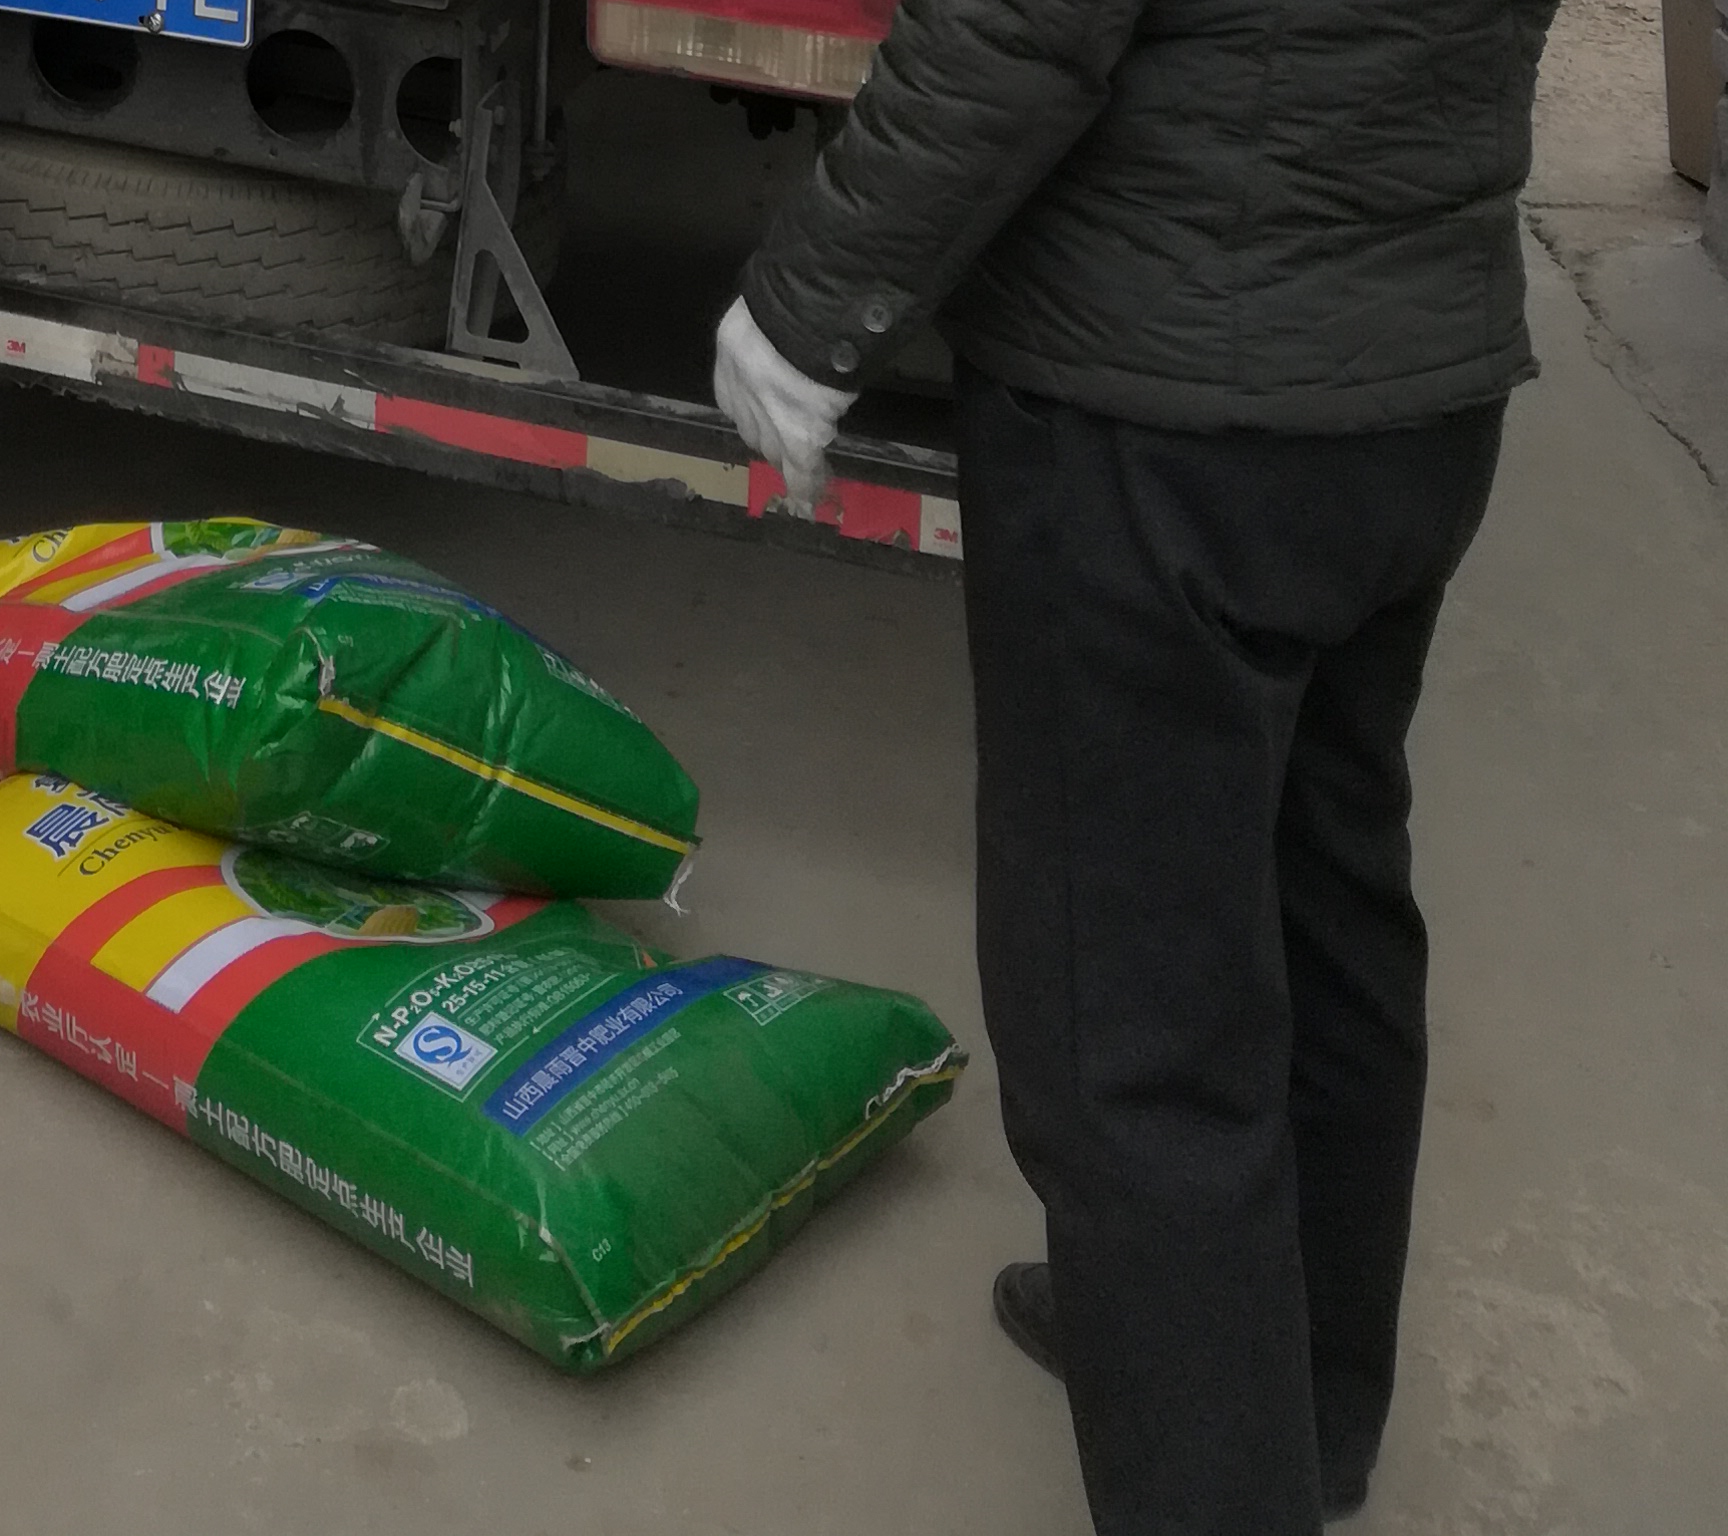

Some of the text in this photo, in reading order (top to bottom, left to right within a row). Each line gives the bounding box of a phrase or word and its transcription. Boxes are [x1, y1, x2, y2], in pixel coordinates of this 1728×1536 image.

[6, 339, 27, 354] 3M
[933, 527, 958, 544] 3M
[78, 820, 171, 878] Chenyu
[502, 981, 684, 1122] 山西晨雨晋中肥业有限公司
[590, 1238, 613, 1265] C13
